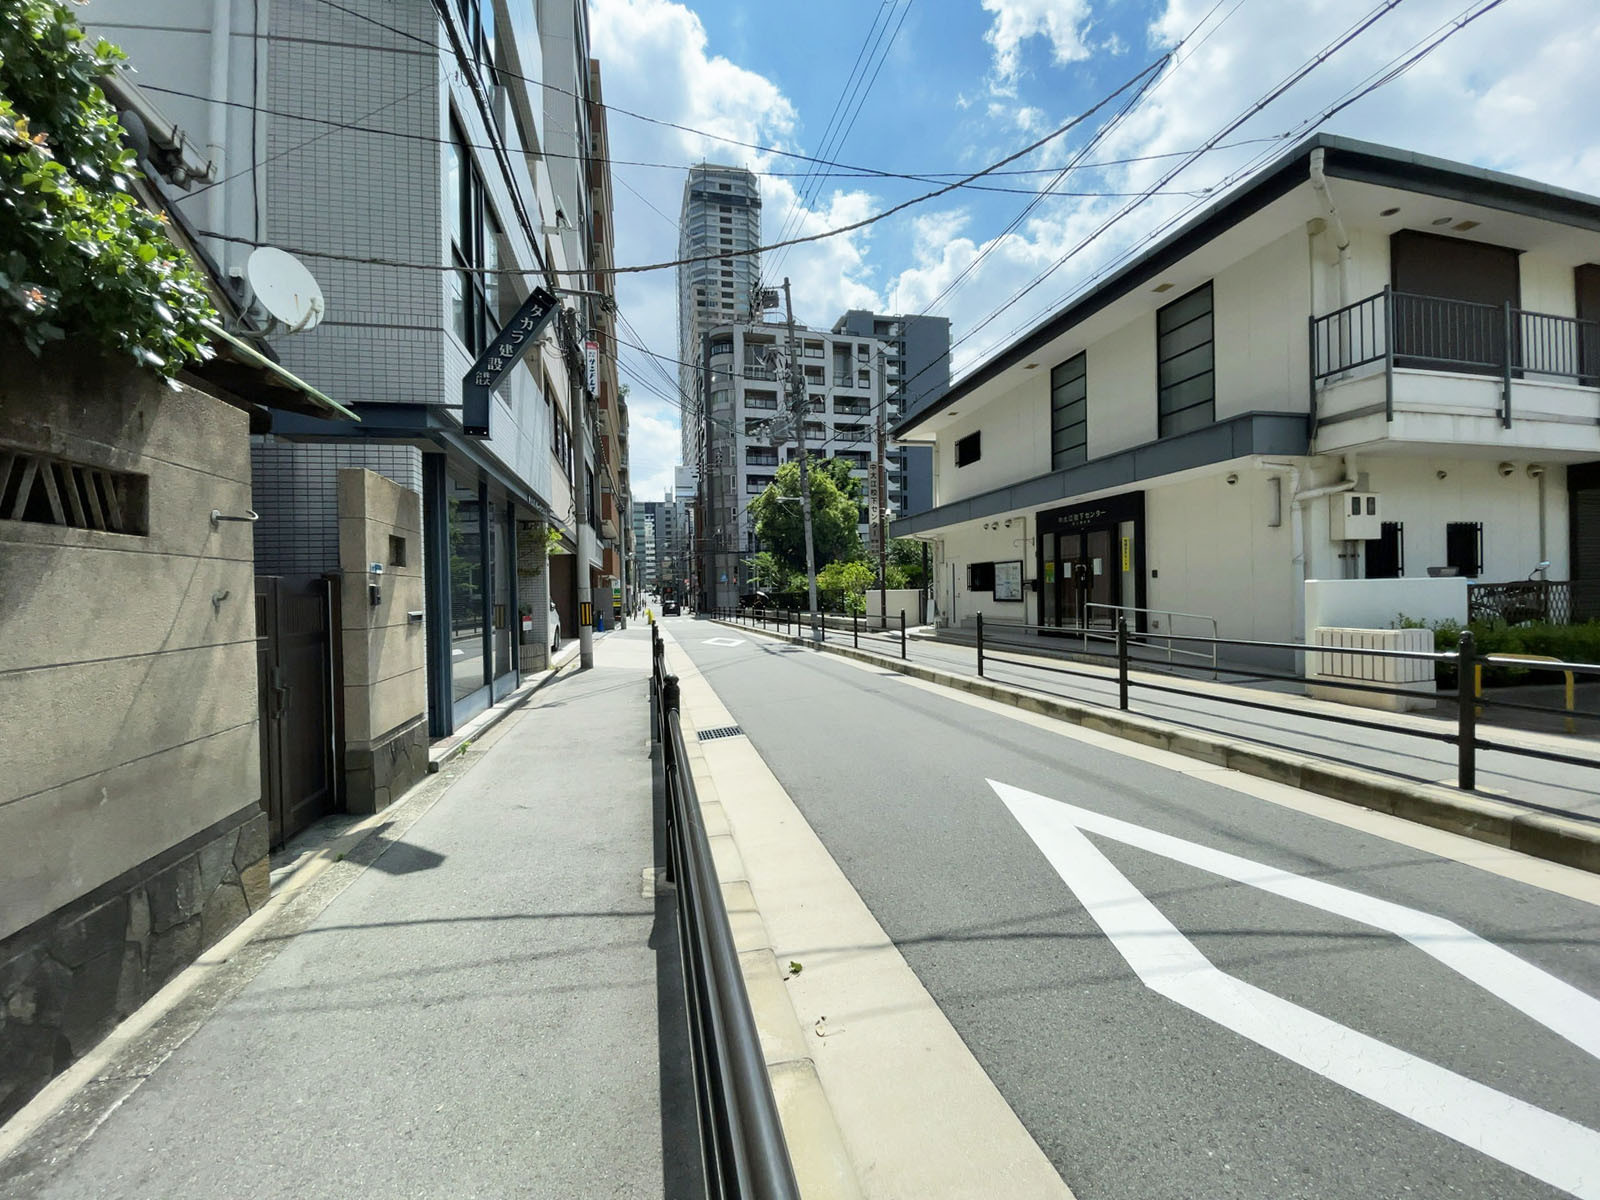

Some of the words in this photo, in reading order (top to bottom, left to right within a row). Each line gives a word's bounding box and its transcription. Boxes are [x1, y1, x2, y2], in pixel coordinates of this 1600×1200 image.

[488, 304, 543, 371] タカラ建設
